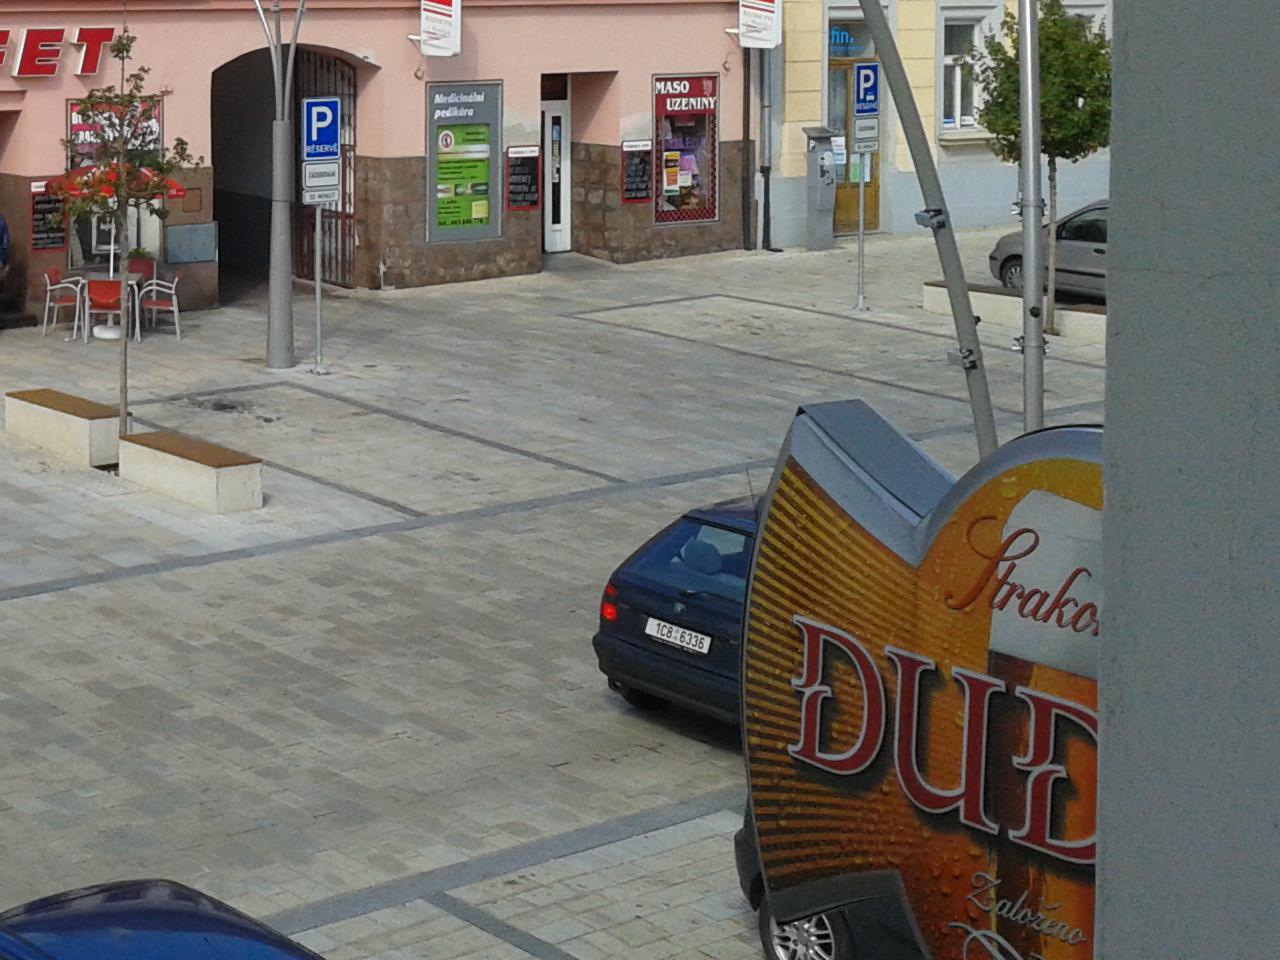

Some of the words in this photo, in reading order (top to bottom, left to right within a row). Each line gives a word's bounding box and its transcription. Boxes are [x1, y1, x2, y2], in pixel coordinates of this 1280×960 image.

[655, 80, 690, 95] MASO
[859, 68, 875, 100] P
[666, 96, 717, 111] UZENINY
[311, 105, 333, 142] P
[655, 622, 673, 639] 1C8
[679, 630, 705, 650] 6336
[964, 871, 1088, 946] Založeno
